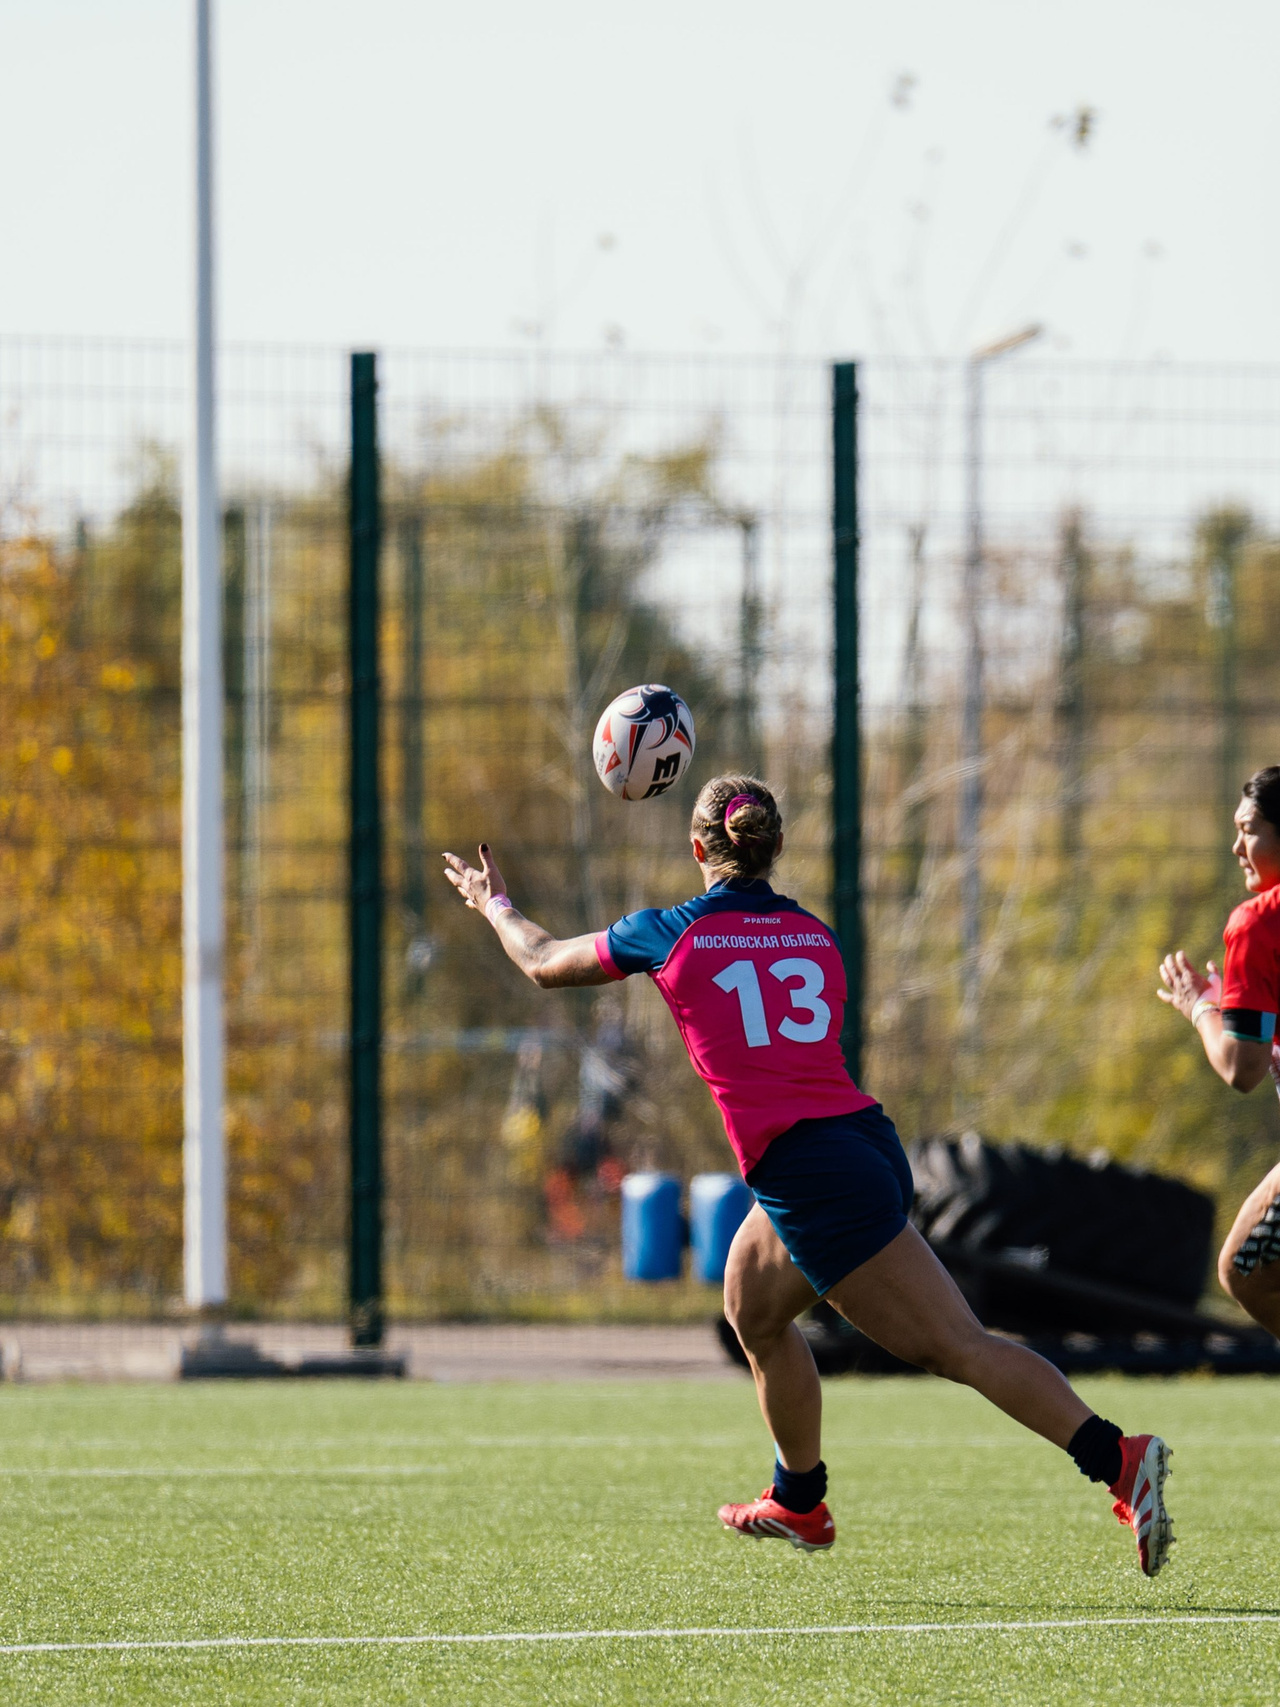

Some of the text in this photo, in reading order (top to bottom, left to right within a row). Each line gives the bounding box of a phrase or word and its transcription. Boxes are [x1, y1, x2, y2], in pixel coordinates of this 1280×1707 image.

[751, 917, 781, 925] PATRICK
[693, 933, 831, 950] МОСКОВСКАЯ ОБЛАСТЬ
[711, 957, 832, 1048] 13
